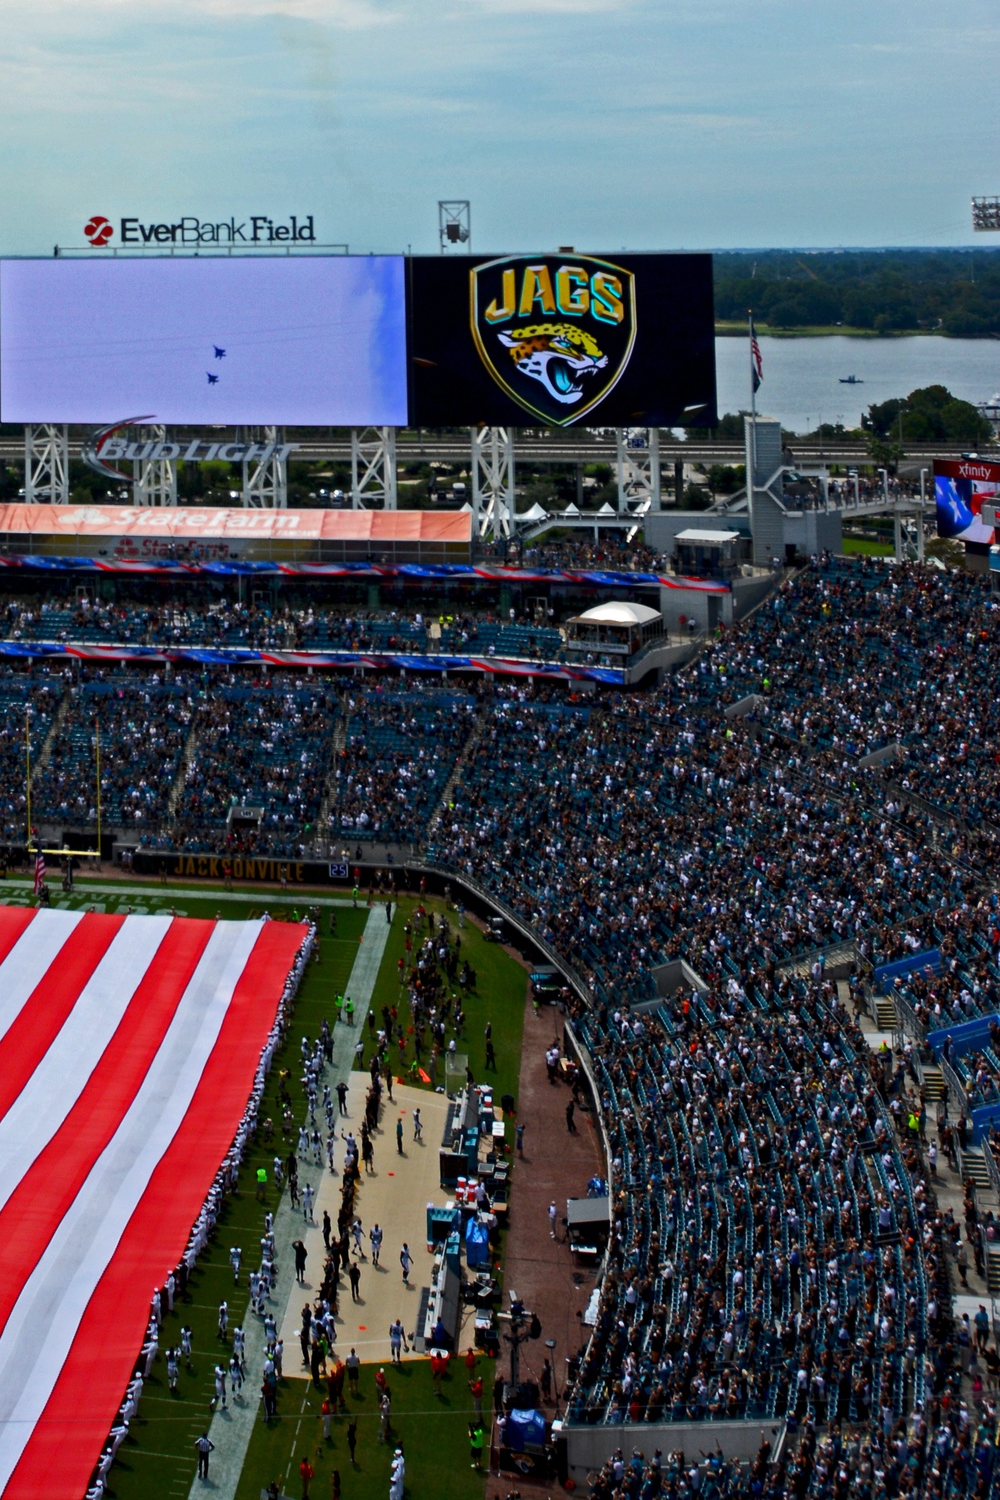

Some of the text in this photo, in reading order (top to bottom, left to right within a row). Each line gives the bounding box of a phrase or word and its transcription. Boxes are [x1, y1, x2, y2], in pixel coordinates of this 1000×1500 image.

[121, 216, 316, 242] EverBank Field
[485, 265, 624, 325] JAGS
[97, 439, 301, 462] BUD LIGHT
[959, 463, 991, 480] xfinity
[331, 865, 346, 876] 25
